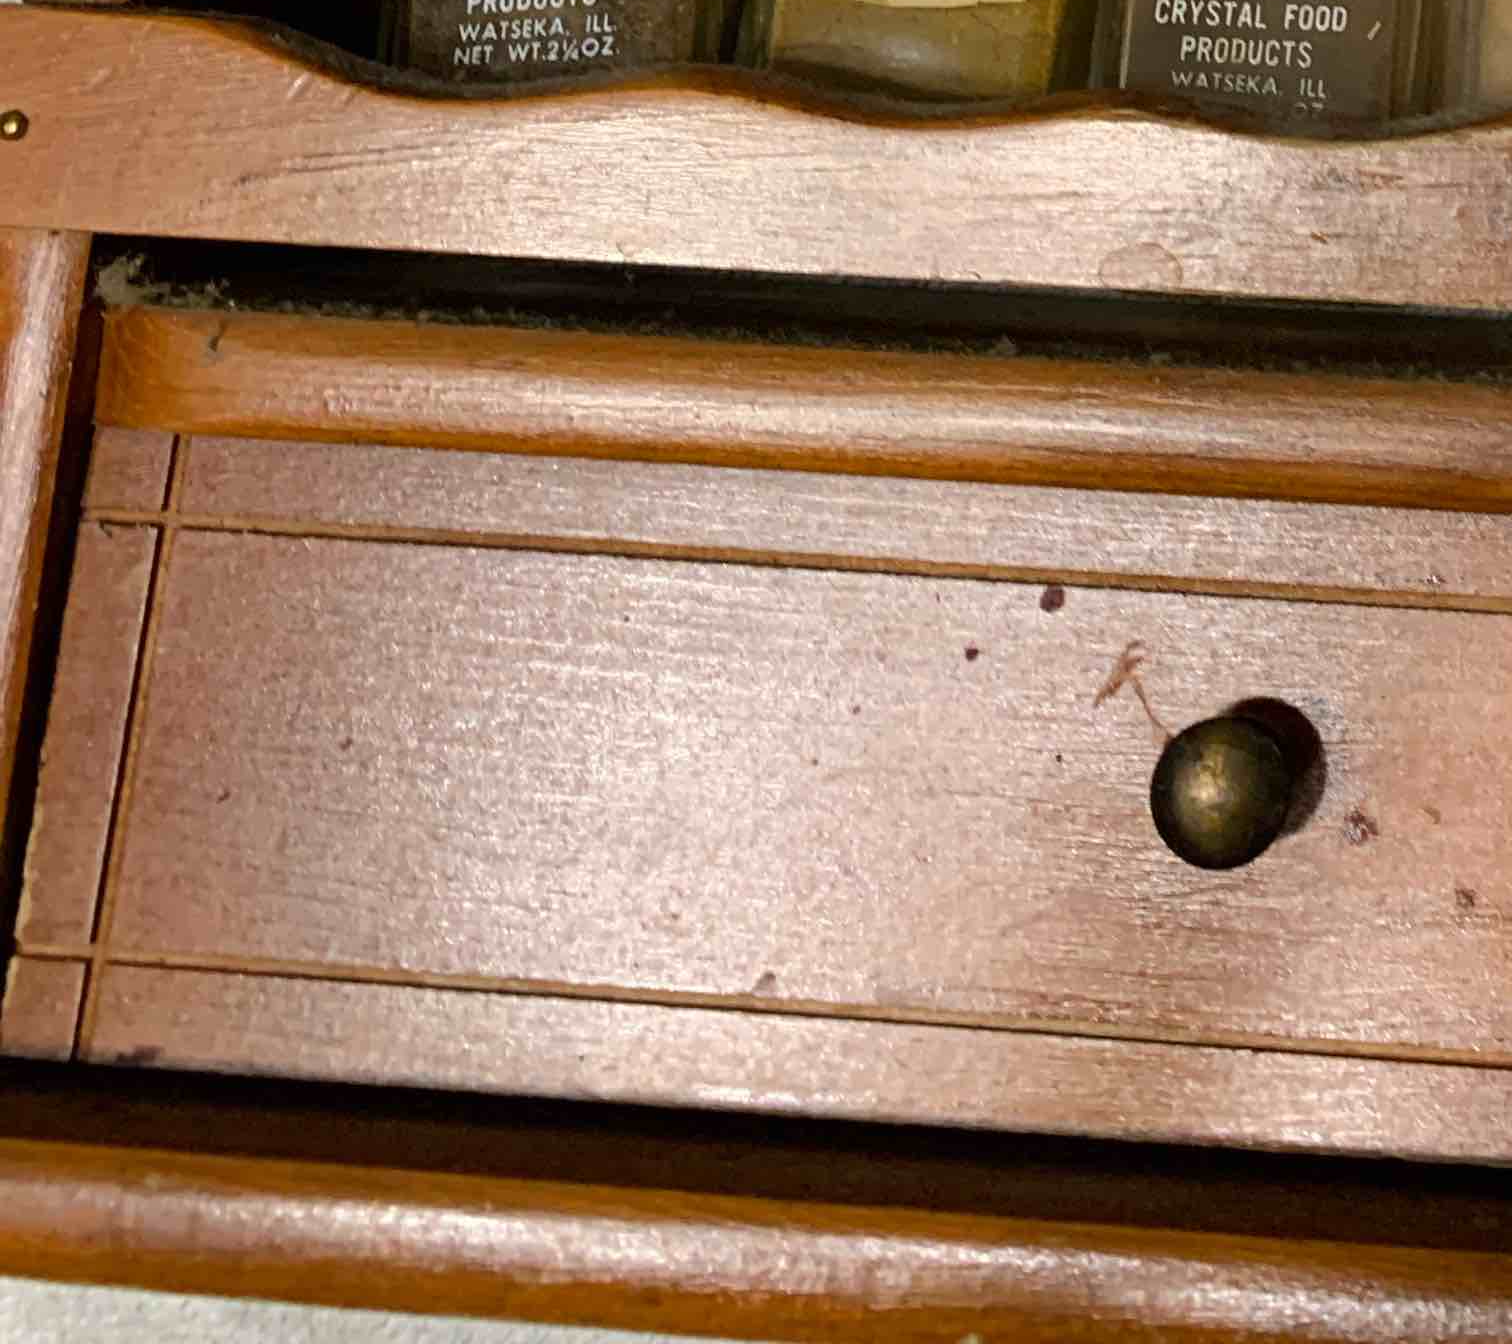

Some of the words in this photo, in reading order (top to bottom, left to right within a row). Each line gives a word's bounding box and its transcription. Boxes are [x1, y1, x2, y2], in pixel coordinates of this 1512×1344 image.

[1284, 3, 1347, 32] FOOD
[453, 44, 494, 65] NET
[1180, 35, 1313, 69] PRODUCTS
